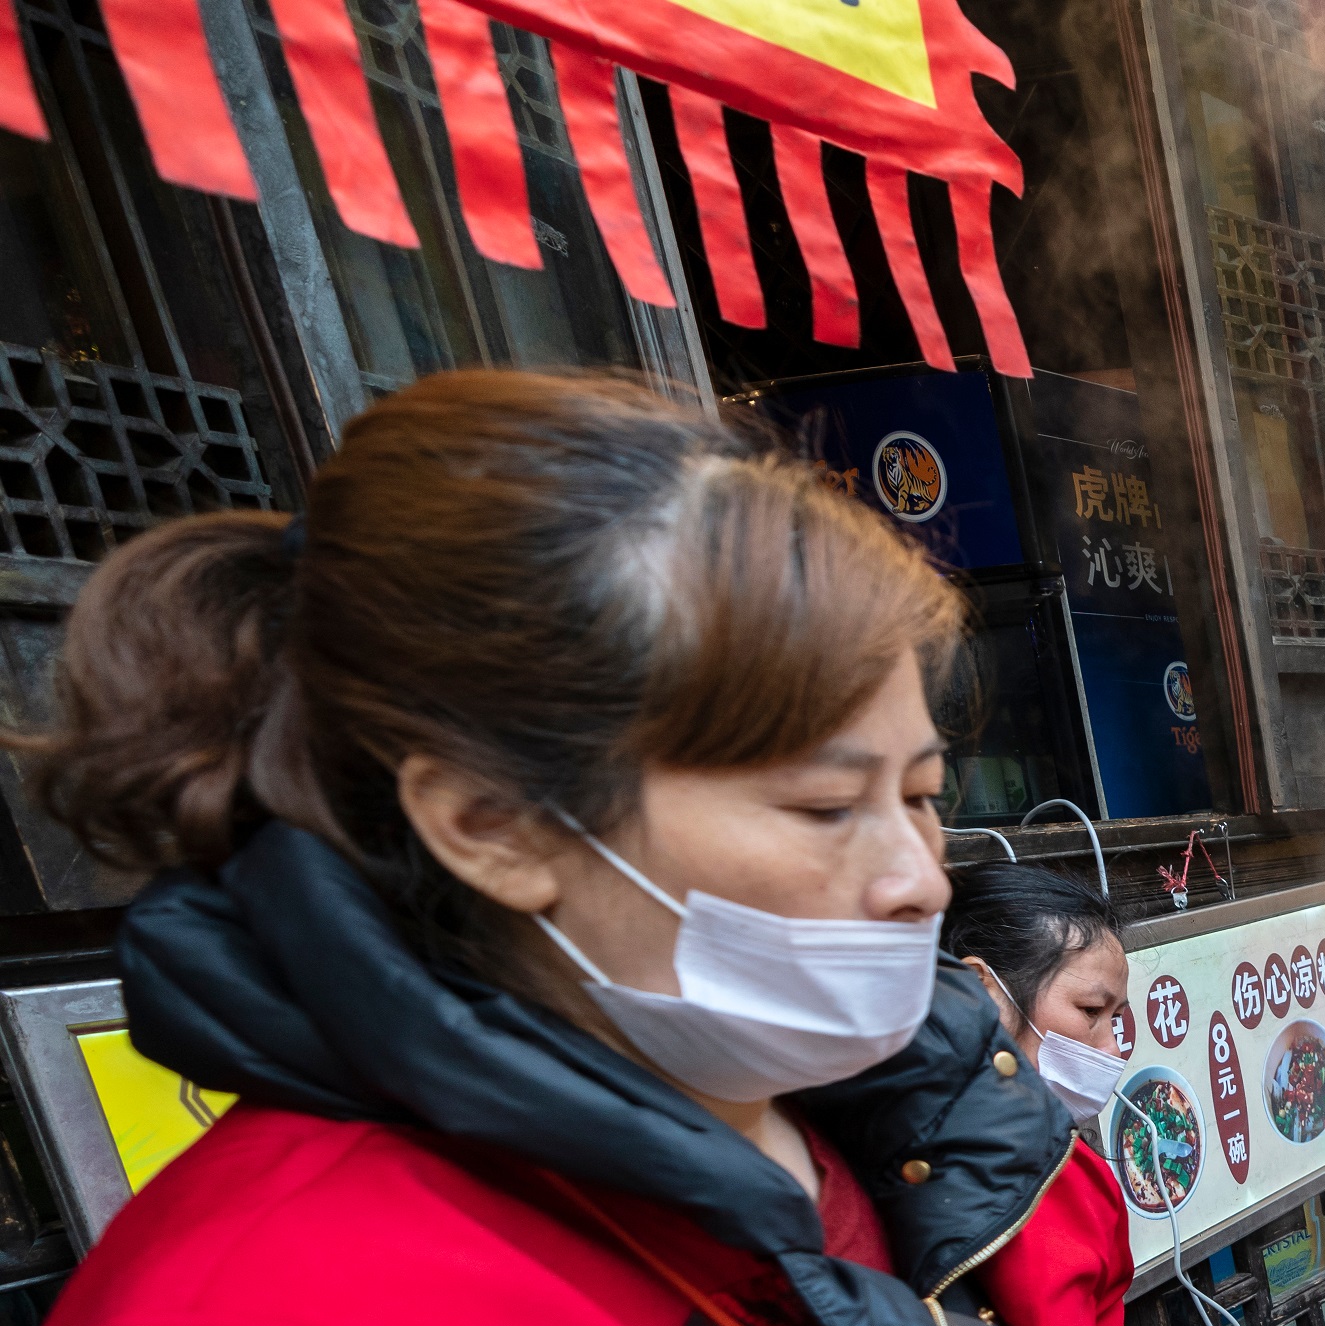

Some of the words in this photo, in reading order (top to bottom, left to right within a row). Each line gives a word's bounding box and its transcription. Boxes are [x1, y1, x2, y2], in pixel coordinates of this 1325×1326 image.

[1072, 465, 1162, 530] 虎牌
[1082, 534, 1174, 596] 沁爽
[1211, 1023, 1248, 1165] 8元一碗
[1263, 1229, 1311, 1258] RYSTAL
